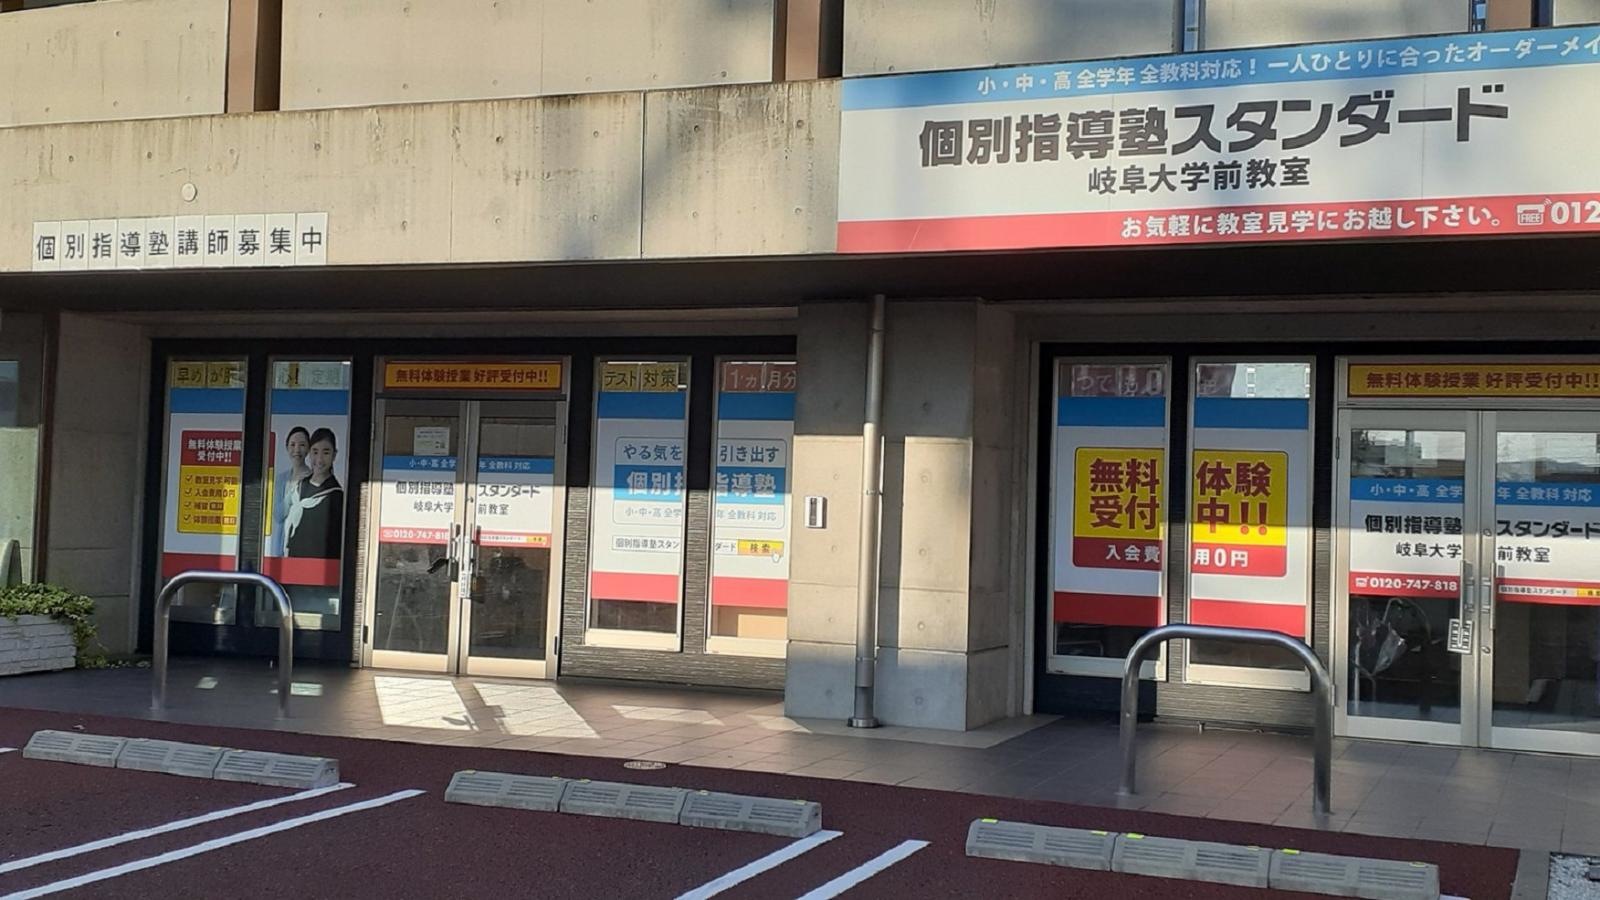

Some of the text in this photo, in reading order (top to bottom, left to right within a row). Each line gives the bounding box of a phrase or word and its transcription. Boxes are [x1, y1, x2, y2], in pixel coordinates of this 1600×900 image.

[978, 69, 1071, 95] 小・中・高
[1076, 65, 1135, 90] 全学年
[1267, 36, 1600, 74] 一人ひとりに合ったオーダーメイ
[919, 84, 1509, 168] 個別指導塾スタンダード
[1088, 156, 1311, 195] 岐阜大学前教室
[1120, 204, 1501, 239] お気軽に教室見学にお越し下さい。
[36, 225, 323, 261] 個別指導塾講師募集中
[395, 369, 469, 384] 無料体験授業
[1366, 371, 1481, 389] 無料体験授業
[623, 445, 780, 463] やる気を 引き出す
[1089, 457, 1272, 497] 無料 体験
[395, 480, 541, 499] 個別指導塾 スタンダード
[1562, 488, 1592, 503] 対応
[413, 501, 510, 516] 岐阜大学 前教室
[1089, 495, 1160, 530] 受付
[1364, 514, 1463, 534] 個別指導塾
[1106, 544, 1249, 568] 入会費 用0円
[1395, 542, 1551, 563] 岐阜大学 前教室
[1369, 576, 1458, 592] 0120-747-818
